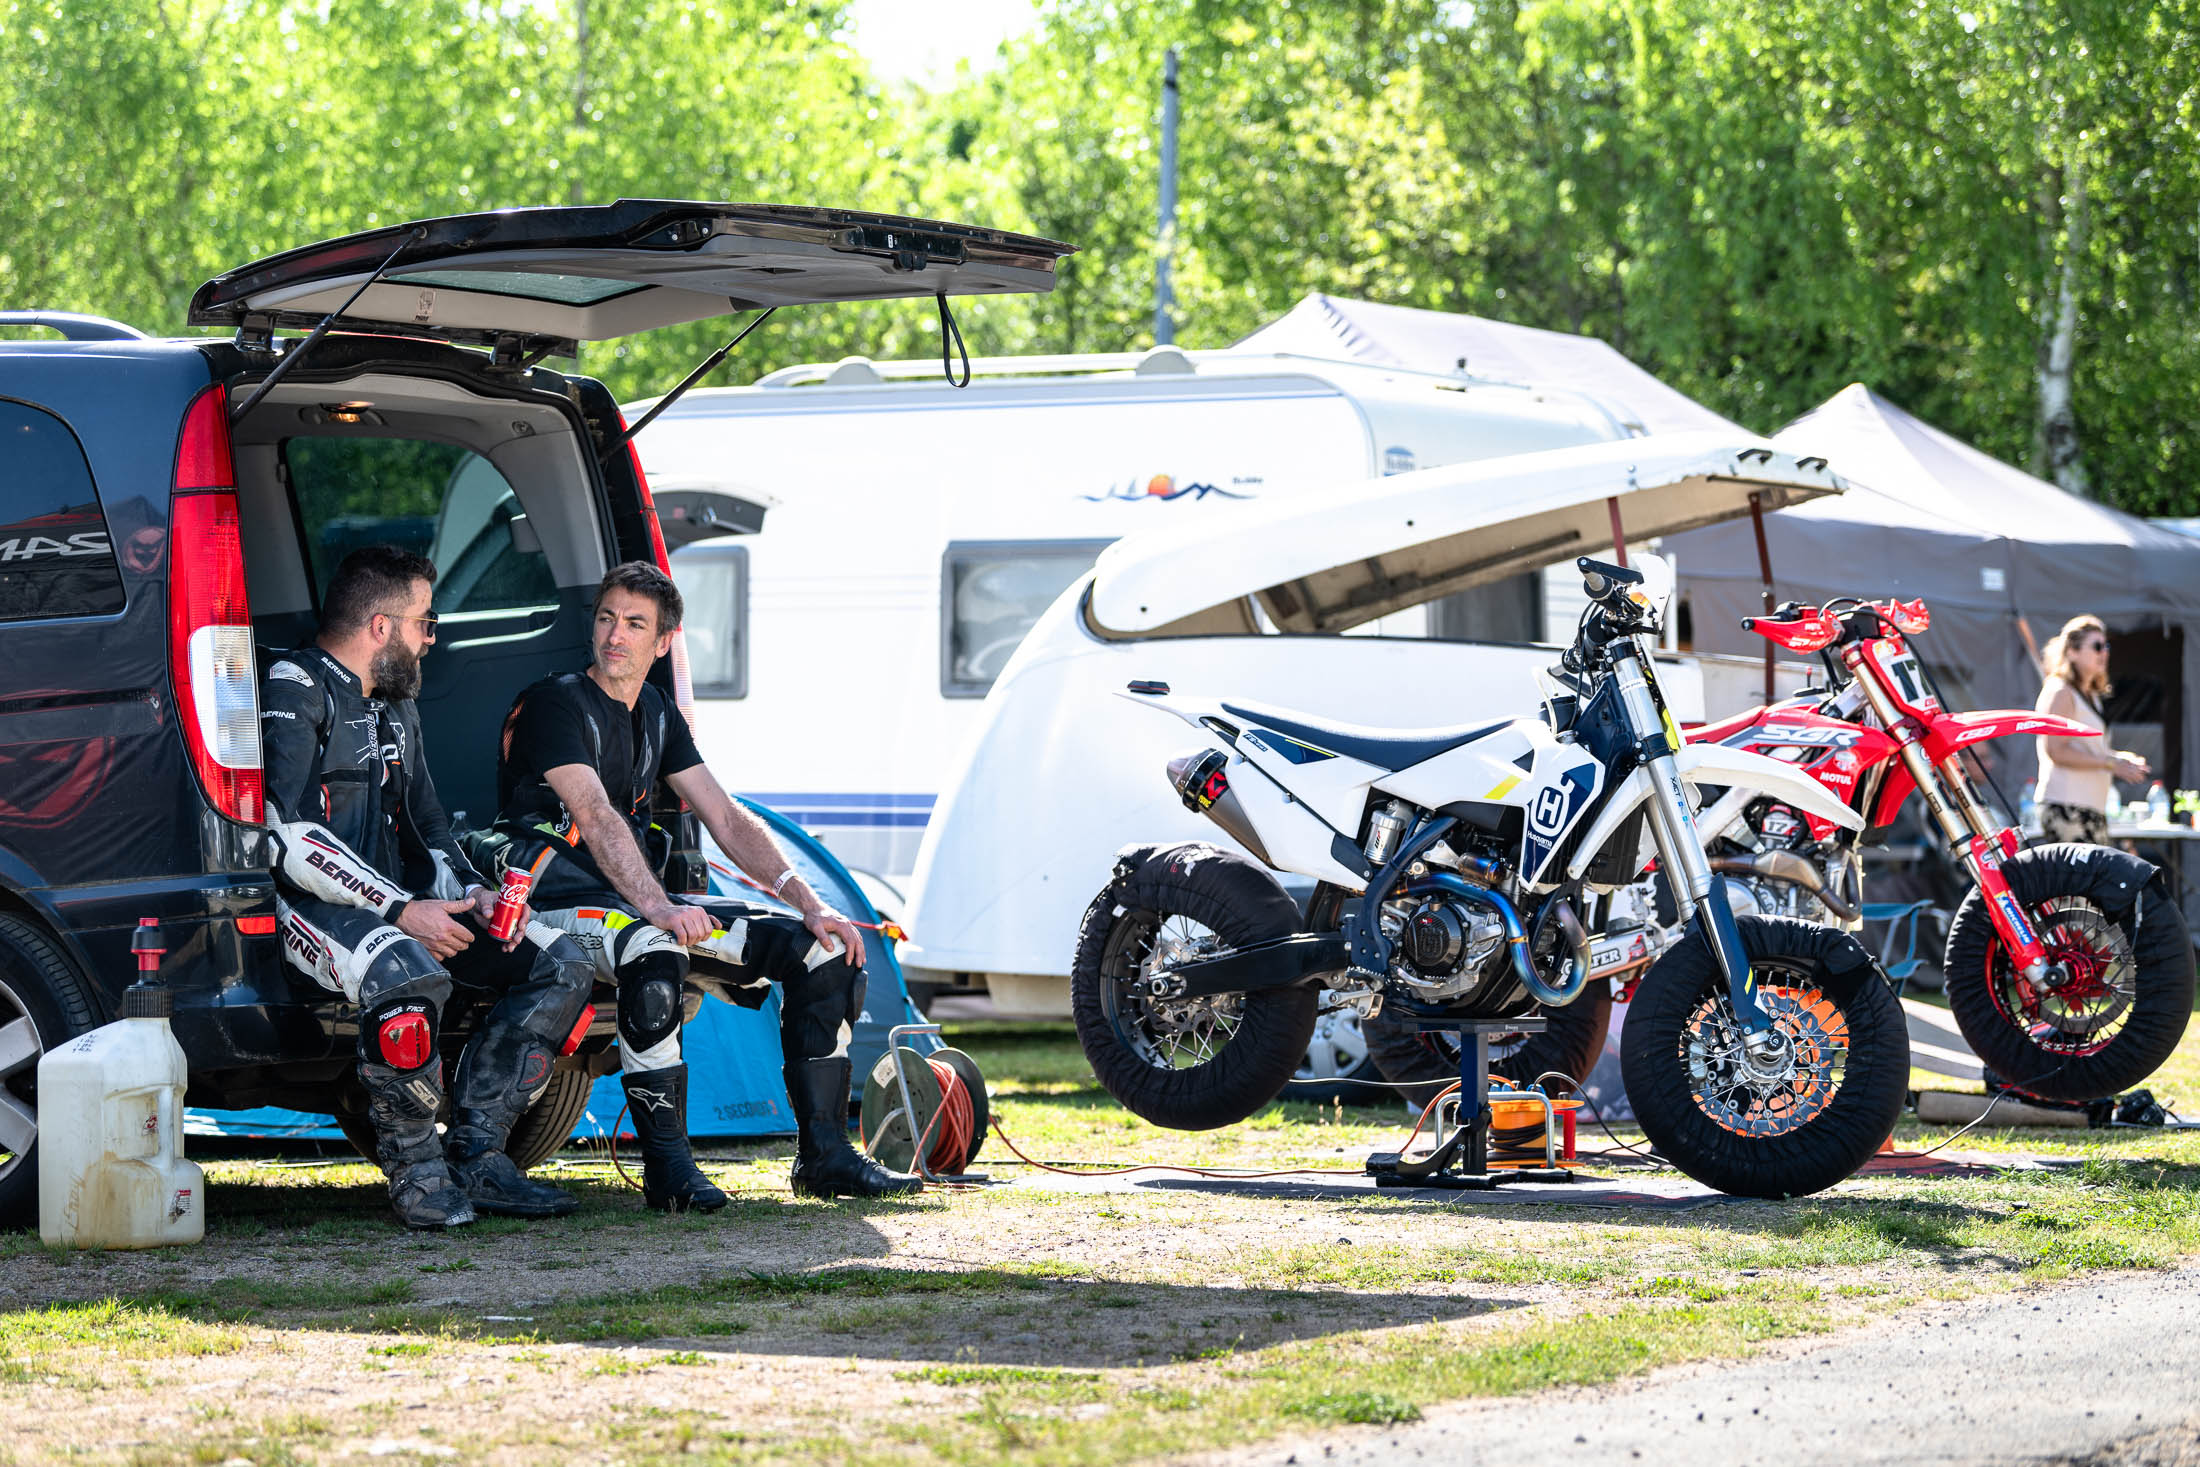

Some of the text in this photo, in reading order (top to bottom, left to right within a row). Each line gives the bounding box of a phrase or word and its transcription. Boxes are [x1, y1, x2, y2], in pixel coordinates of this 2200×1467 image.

[321, 656, 351, 684] BERING
[1891, 659, 1932, 703] 17
[1819, 772, 1852, 785] MOTUL
[1768, 821, 1788, 834] 17
[304, 850, 387, 908] BERING
[281, 924, 319, 969] RING
[379, 1006, 404, 1021] POWER
